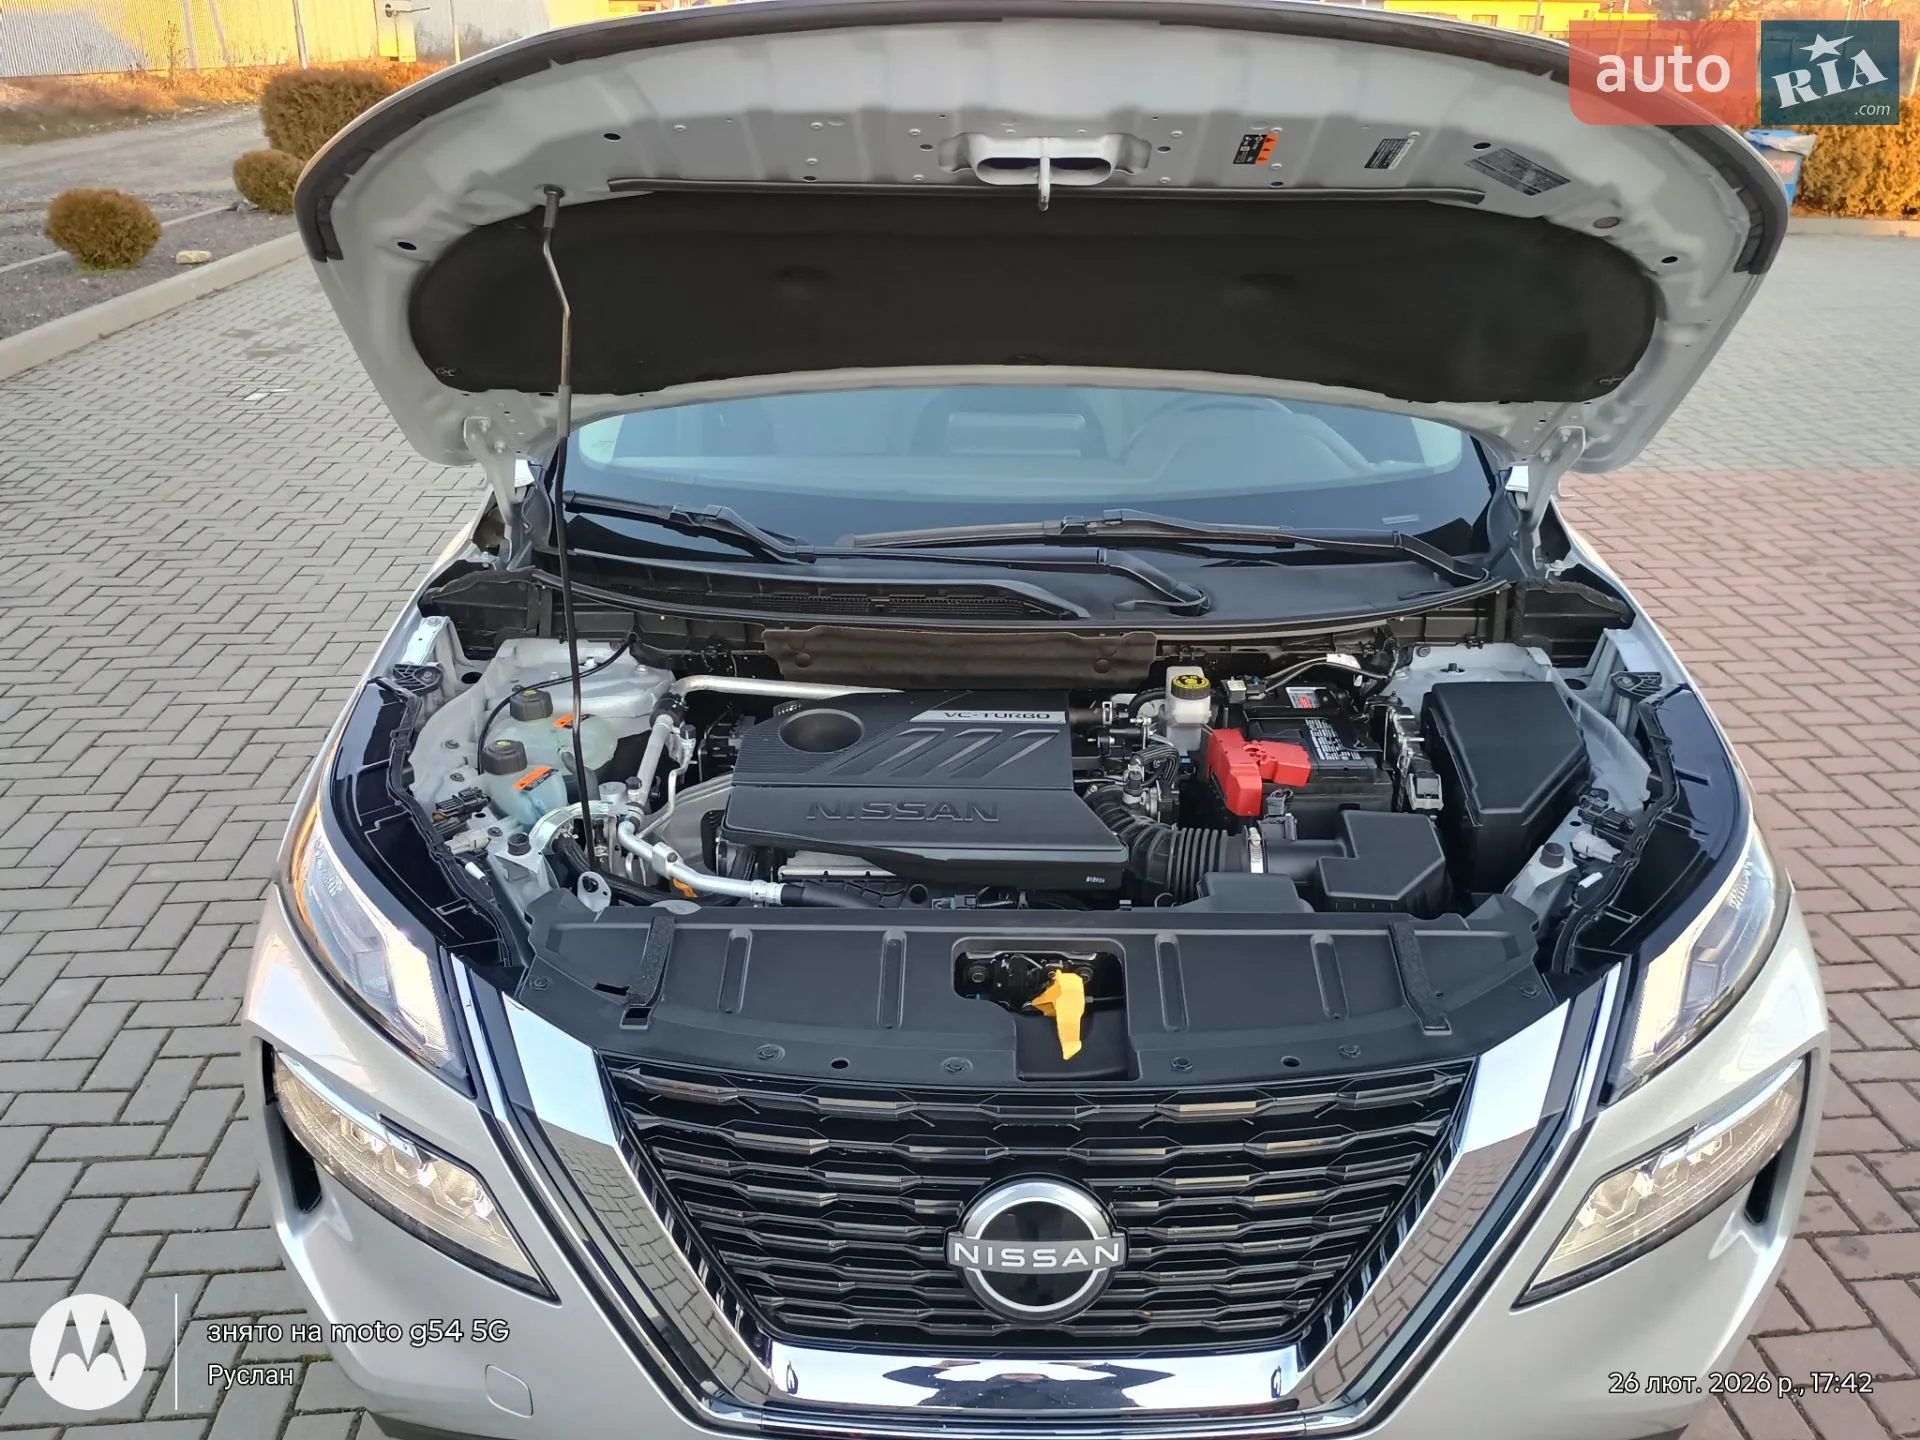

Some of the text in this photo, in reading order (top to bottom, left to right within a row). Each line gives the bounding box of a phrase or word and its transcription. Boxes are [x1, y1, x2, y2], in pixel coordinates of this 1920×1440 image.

[944, 711, 1051, 720] VC-TURBO
[806, 801, 1000, 823] NISSAN
[953, 1241, 1120, 1269] NISSAN
